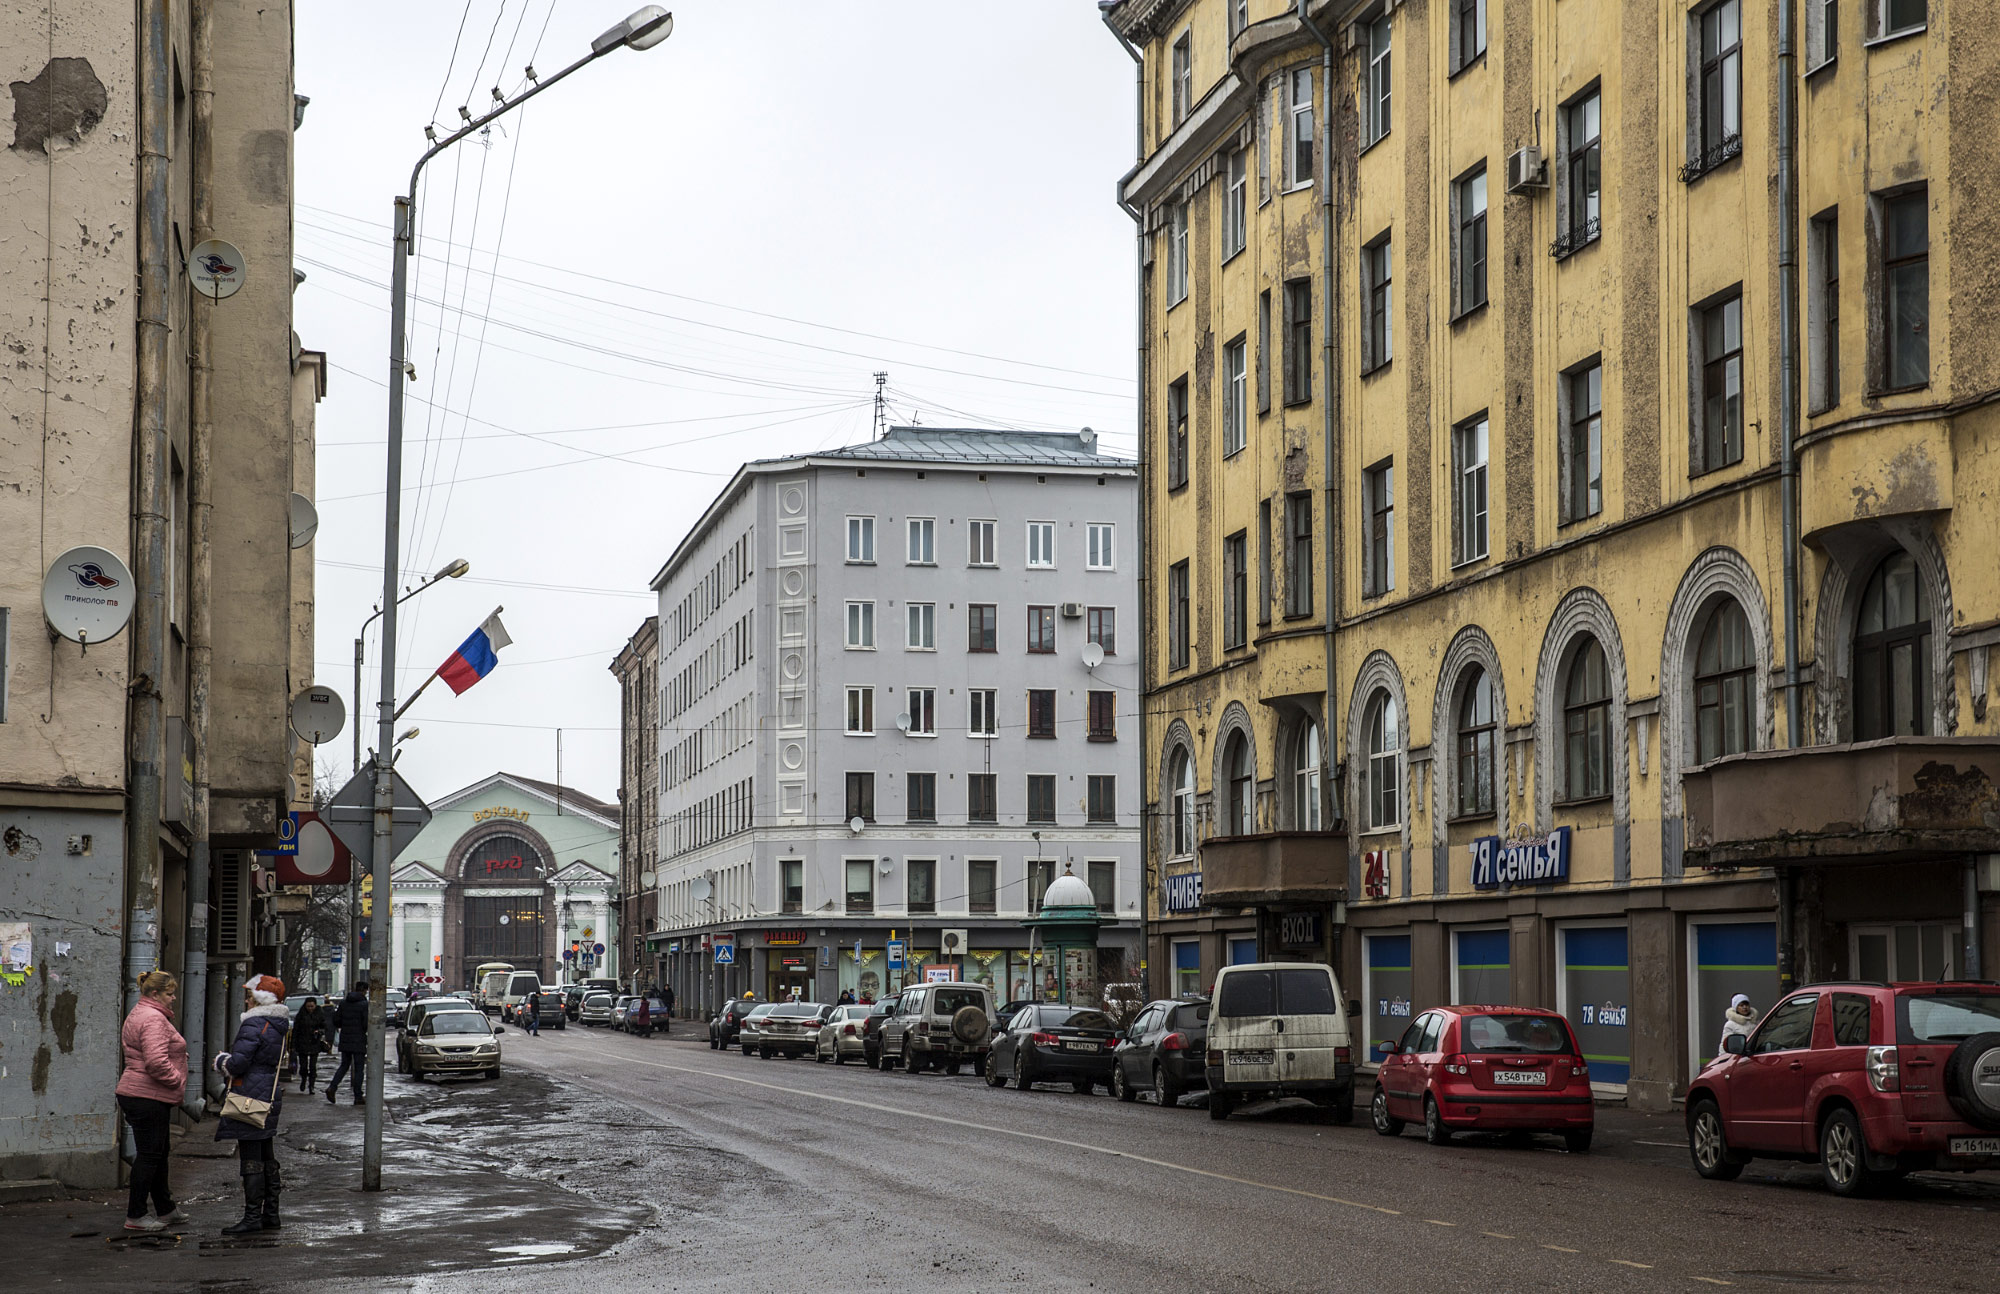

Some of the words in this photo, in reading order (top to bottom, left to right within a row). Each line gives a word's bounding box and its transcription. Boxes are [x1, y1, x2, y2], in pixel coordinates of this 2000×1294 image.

[472, 806, 530, 822] ВОКЗАЛ
[1365, 850, 1384, 886] 24
[1469, 840, 1491, 885] 7Я
[1496, 831, 1561, 883] семьЯ
[1281, 916, 1314, 943] ВХОД
[1379, 1000, 1388, 1016] 7Я
[1582, 1005, 1594, 1024] 7Я
[1599, 1007, 1627, 1026] семьЯ
[1983, 1065, 2000, 1074] SU
